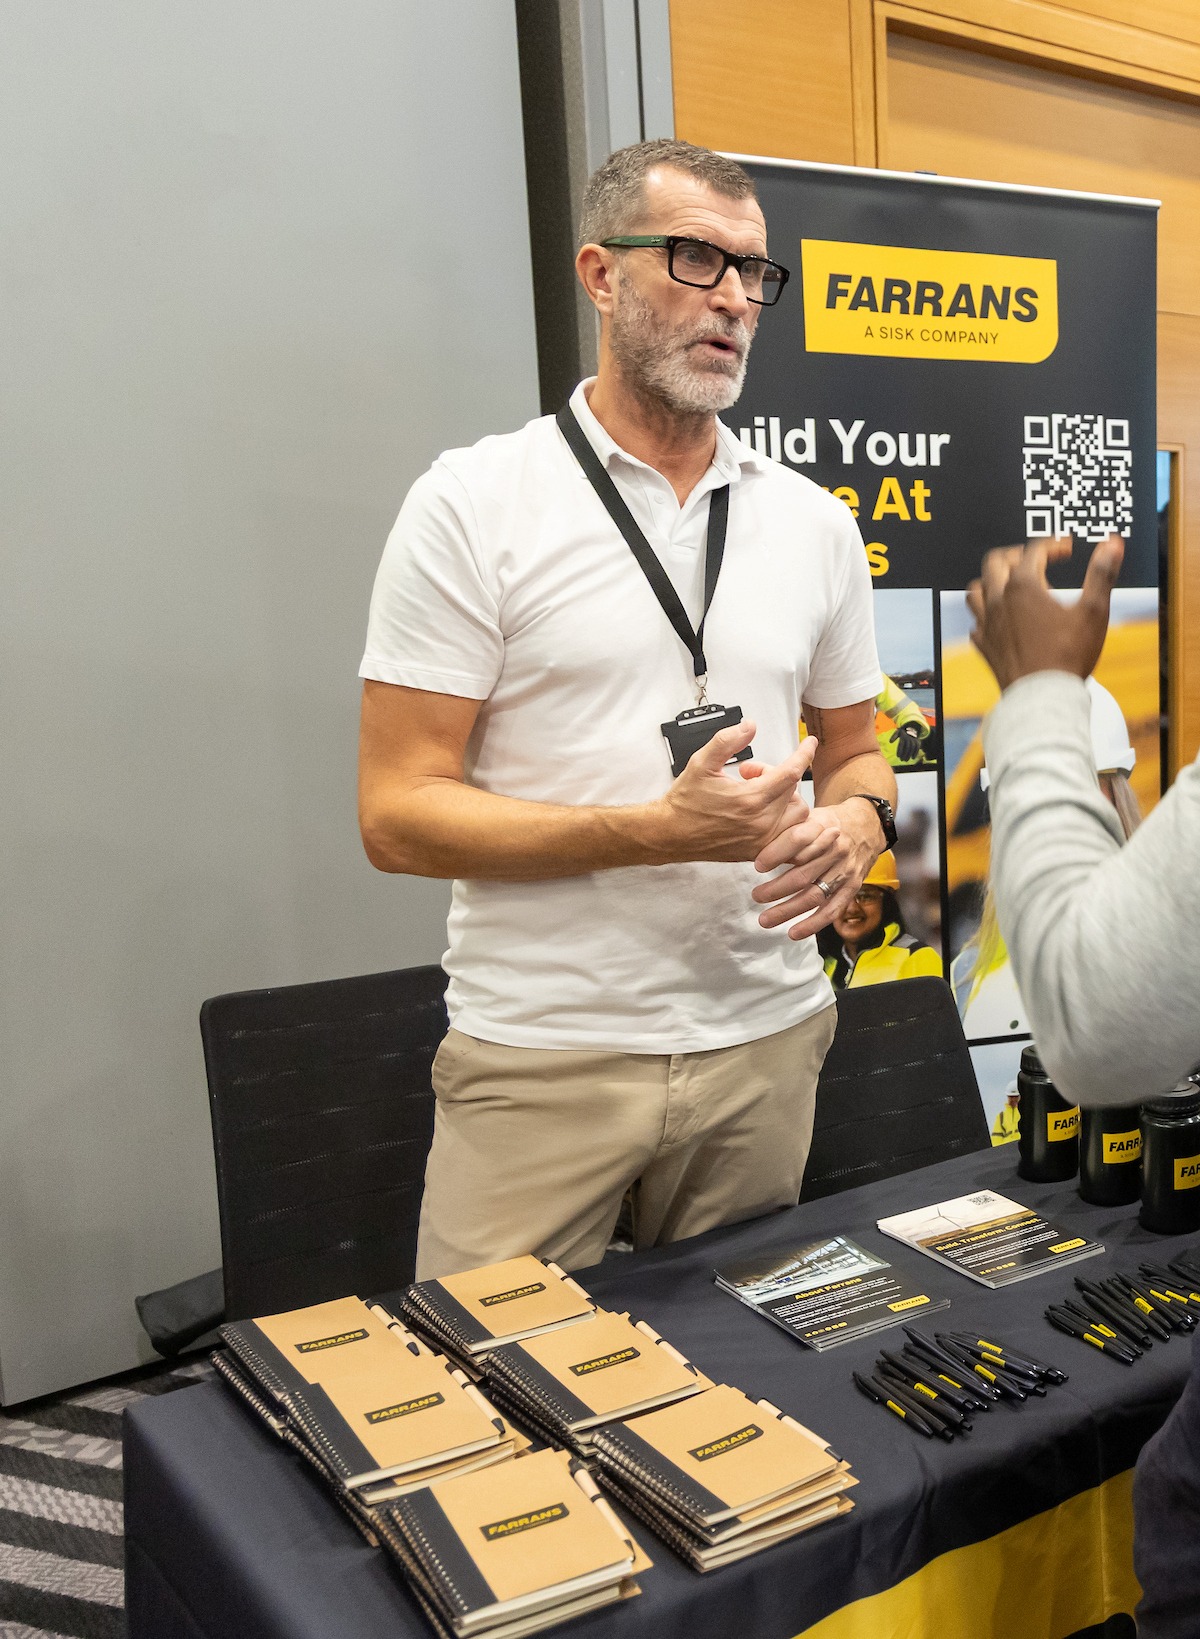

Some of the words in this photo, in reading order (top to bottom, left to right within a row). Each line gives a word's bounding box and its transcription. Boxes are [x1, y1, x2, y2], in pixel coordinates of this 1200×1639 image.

[825, 273, 1039, 323] FARRANS
[864, 326, 875, 339] A
[879, 326, 915, 341] SISK
[920, 328, 1000, 345] COMPANY
[728, 416, 817, 464] ild
[828, 419, 951, 467] Your
[872, 477, 932, 522] At
[1054, 1114, 1080, 1131] FARR
[1109, 1138, 1142, 1152] FARR
[485, 1284, 541, 1304] FARRANS
[794, 1287, 825, 1300] About
[824, 1277, 863, 1292] Farrans
[302, 1331, 364, 1350] FARRANS
[576, 1350, 634, 1373] FARRANS
[371, 1396, 439, 1420] FARRANS
[697, 1427, 757, 1458] FARRANS
[488, 1507, 562, 1536] FARRANS
